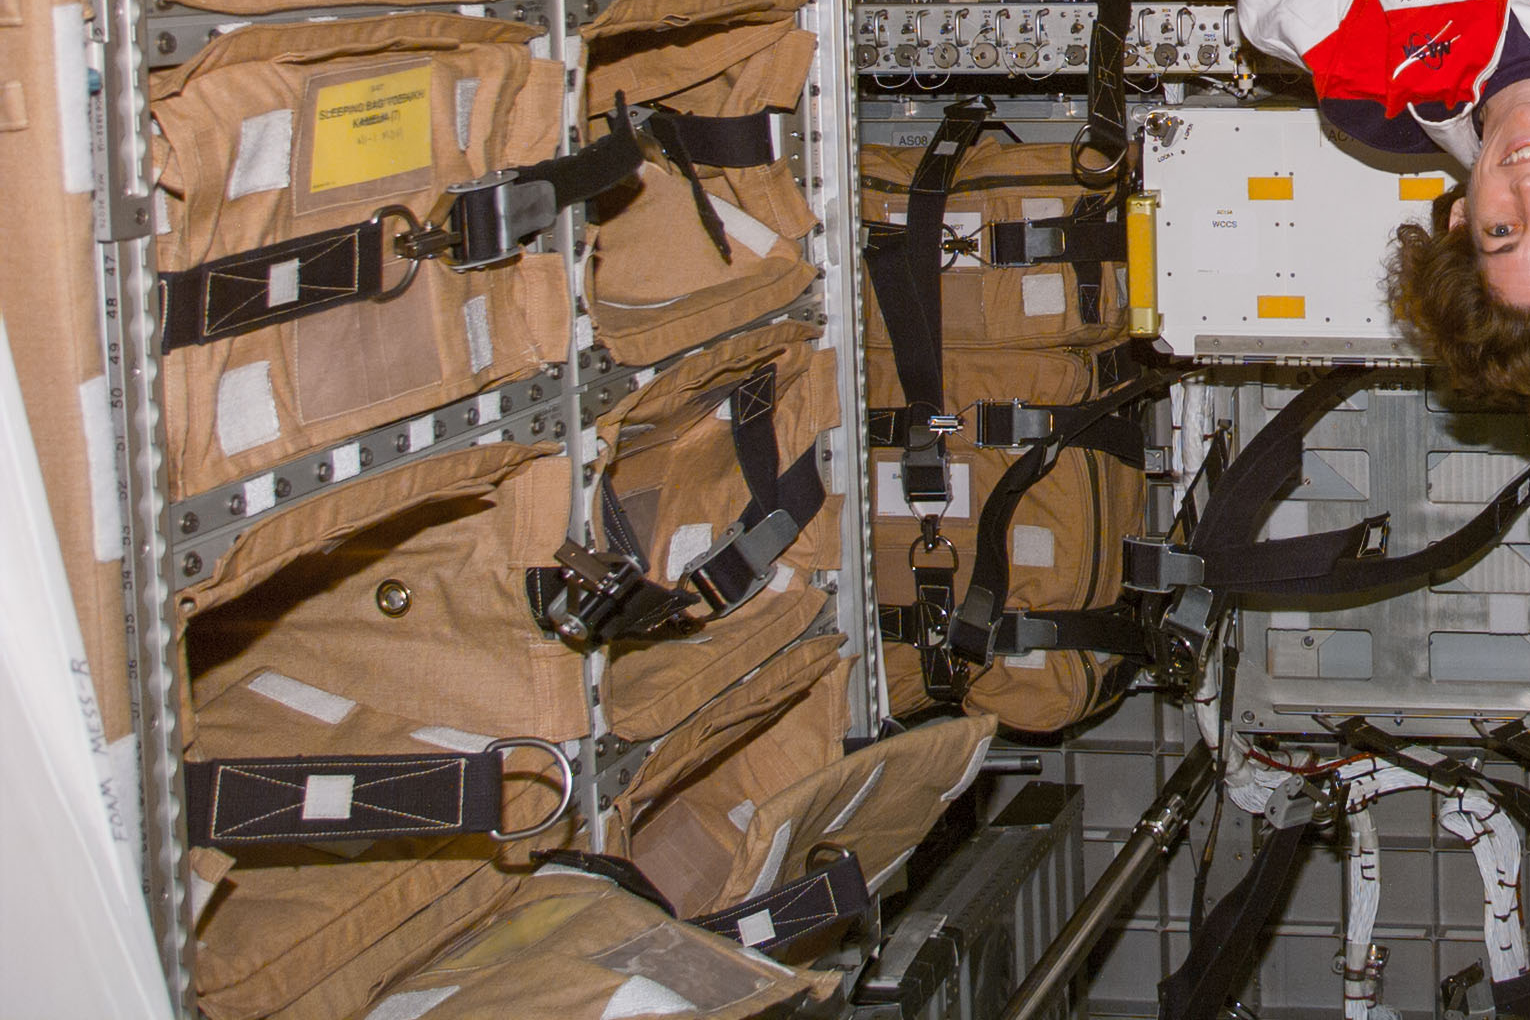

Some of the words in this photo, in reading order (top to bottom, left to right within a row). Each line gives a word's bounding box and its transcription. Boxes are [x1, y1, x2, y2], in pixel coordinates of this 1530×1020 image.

[899, 135, 928, 146] AS08
[105, 255, 116, 276] 47
[106, 297, 118, 319] 48
[108, 342, 120, 365] 49
[110, 387, 123, 408] 50
[100, 778, 129, 842] FOAM
